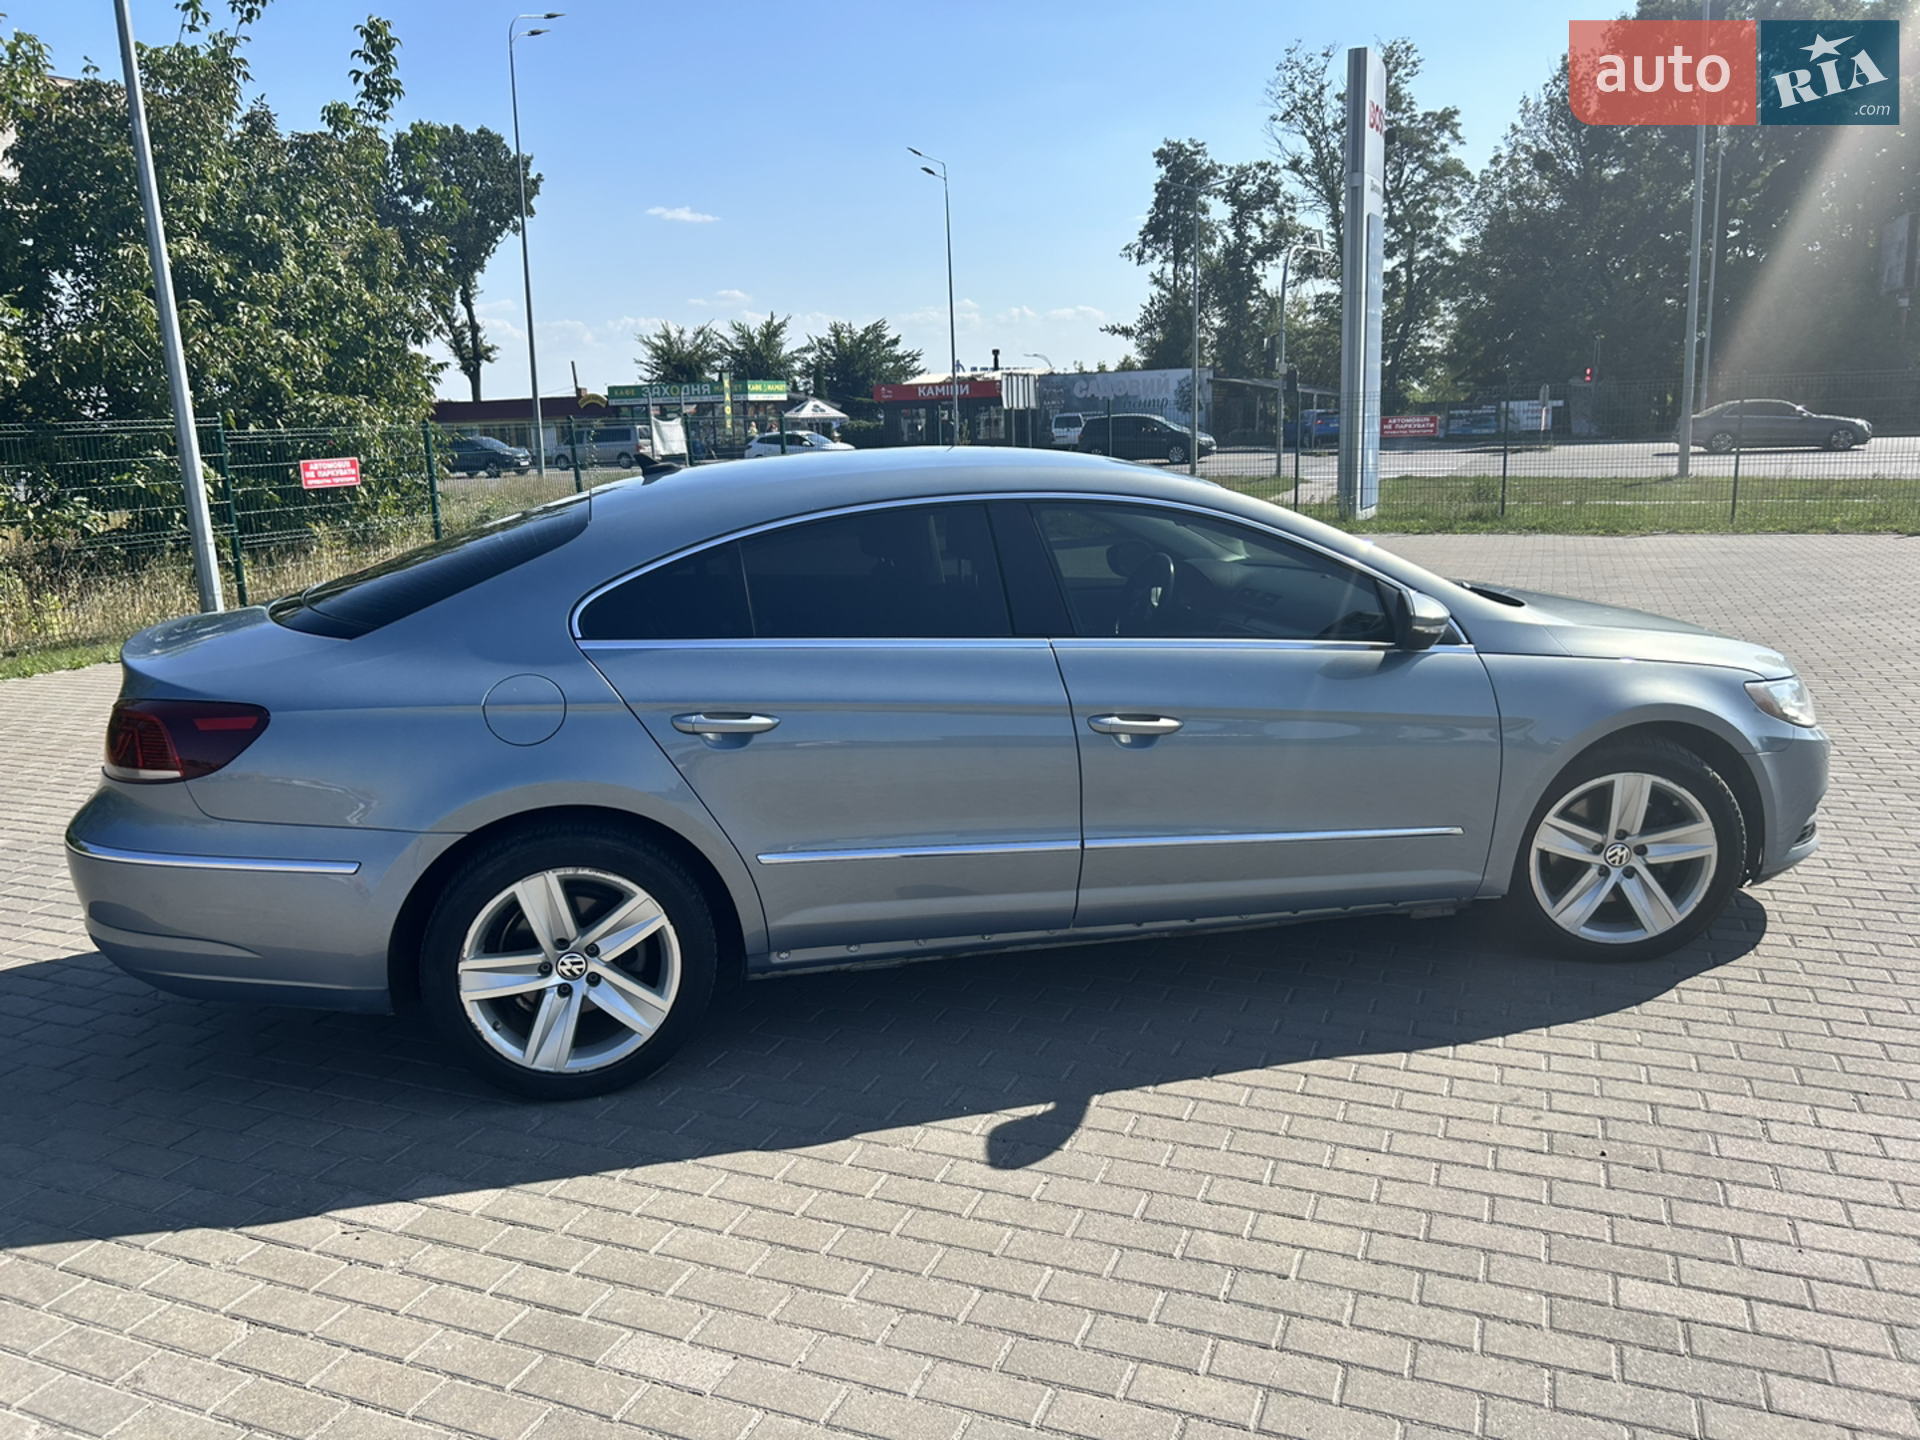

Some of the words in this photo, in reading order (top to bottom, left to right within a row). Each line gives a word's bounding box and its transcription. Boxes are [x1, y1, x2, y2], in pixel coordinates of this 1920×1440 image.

[614, 388, 636, 396] КАФЕ
[641, 384, 711, 397] ЗАХОДНЯ
[1073, 373, 1170, 400] САДОВИЙ
